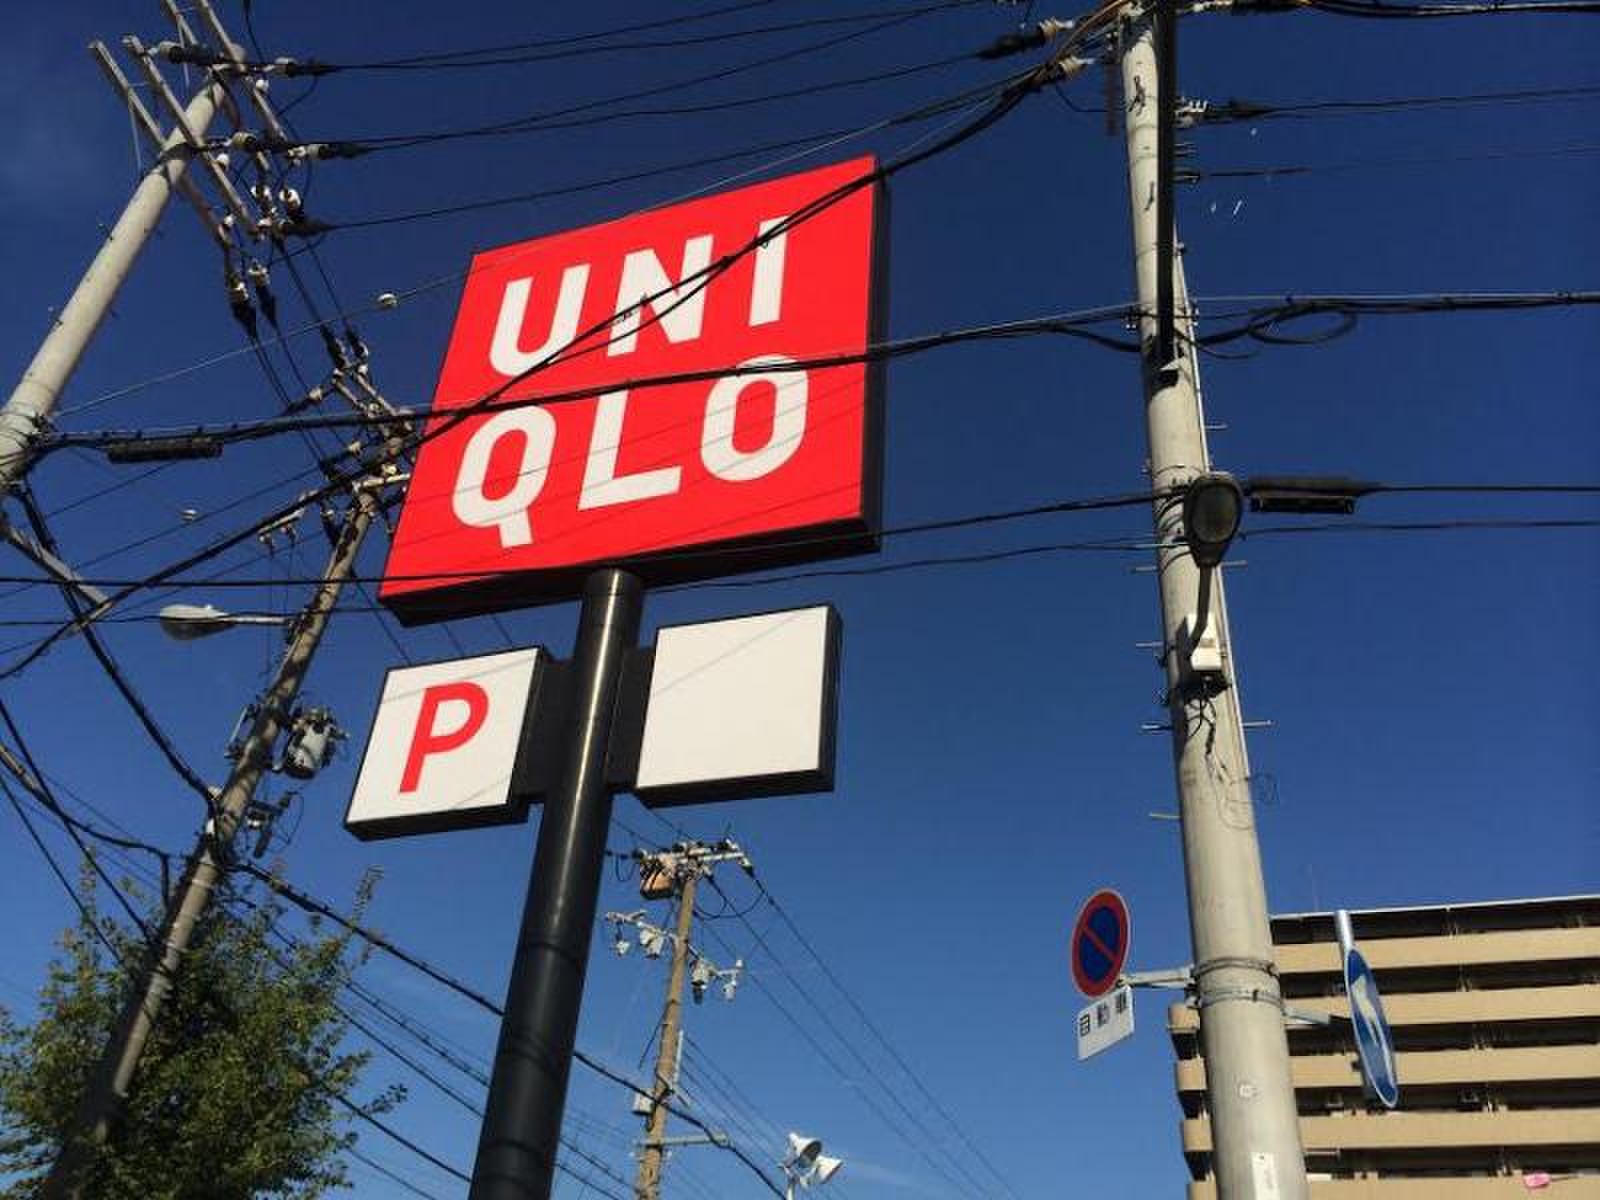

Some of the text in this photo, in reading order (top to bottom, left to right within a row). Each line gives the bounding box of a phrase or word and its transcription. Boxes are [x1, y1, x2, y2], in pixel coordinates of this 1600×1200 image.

[489, 215, 790, 377] UNI
[452, 355, 810, 549] QLO
[399, 681, 490, 793] P
